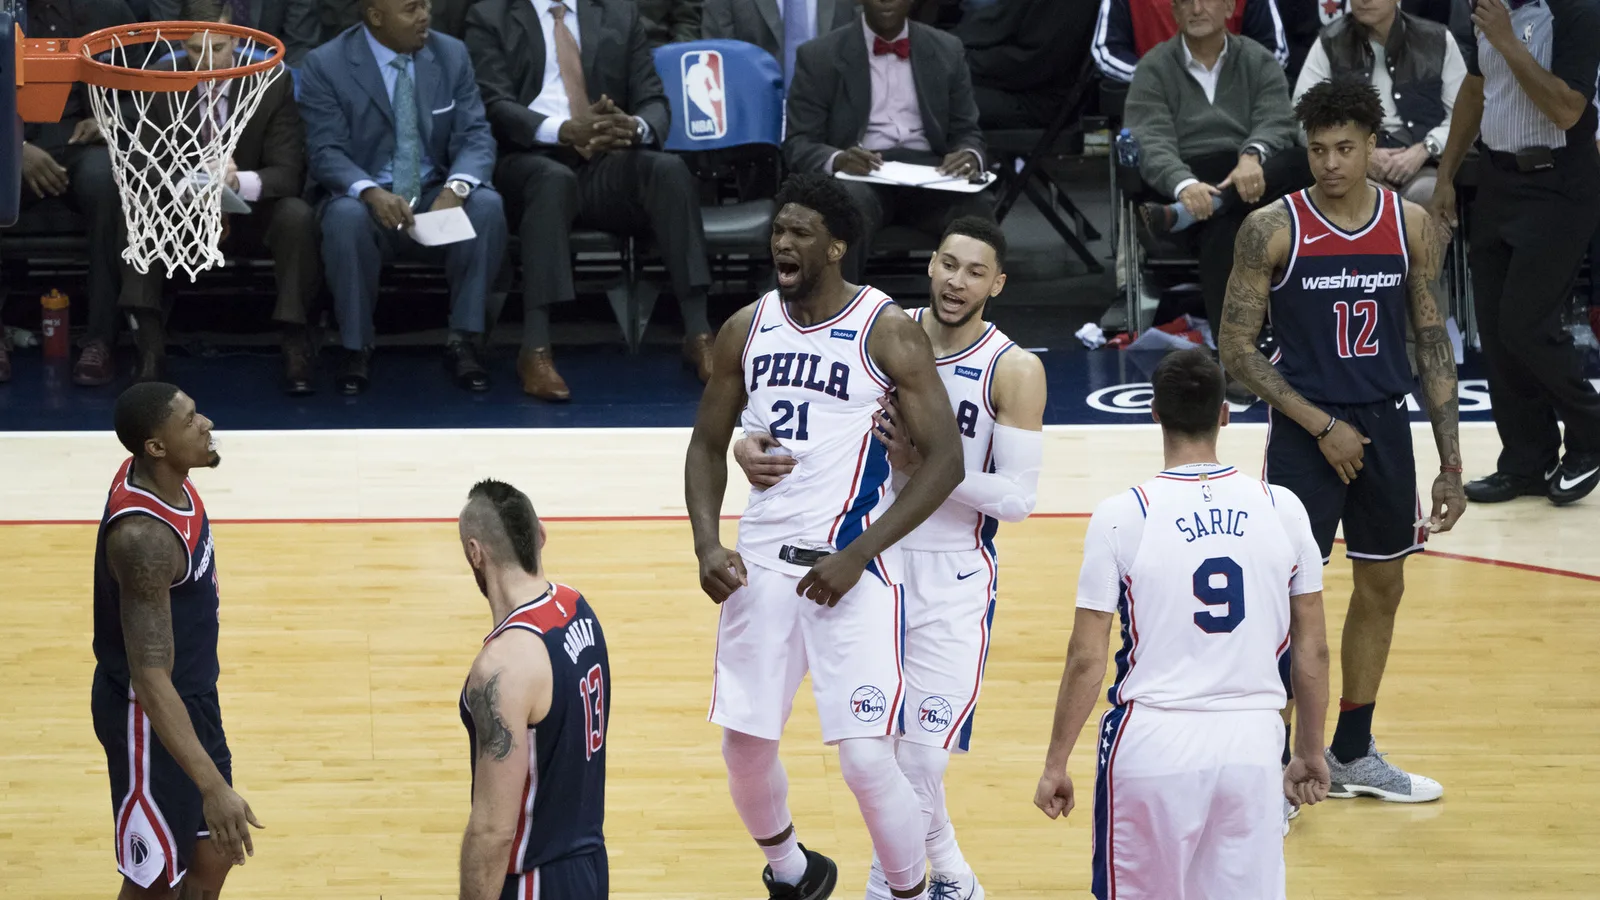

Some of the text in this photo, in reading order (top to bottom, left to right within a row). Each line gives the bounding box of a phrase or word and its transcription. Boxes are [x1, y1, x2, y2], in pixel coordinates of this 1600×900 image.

[691, 119, 714, 133] NBA
[1302, 267, 1402, 293] washington
[1333, 300, 1379, 358] 12
[750, 352, 850, 401] PHILA
[769, 400, 810, 441] 21
[1175, 508, 1248, 543] SARIC
[1192, 556, 1246, 634] 9
[579, 663, 604, 762] 13
[853, 698, 884, 713] 76ers
[920, 707, 948, 725] 76ers
